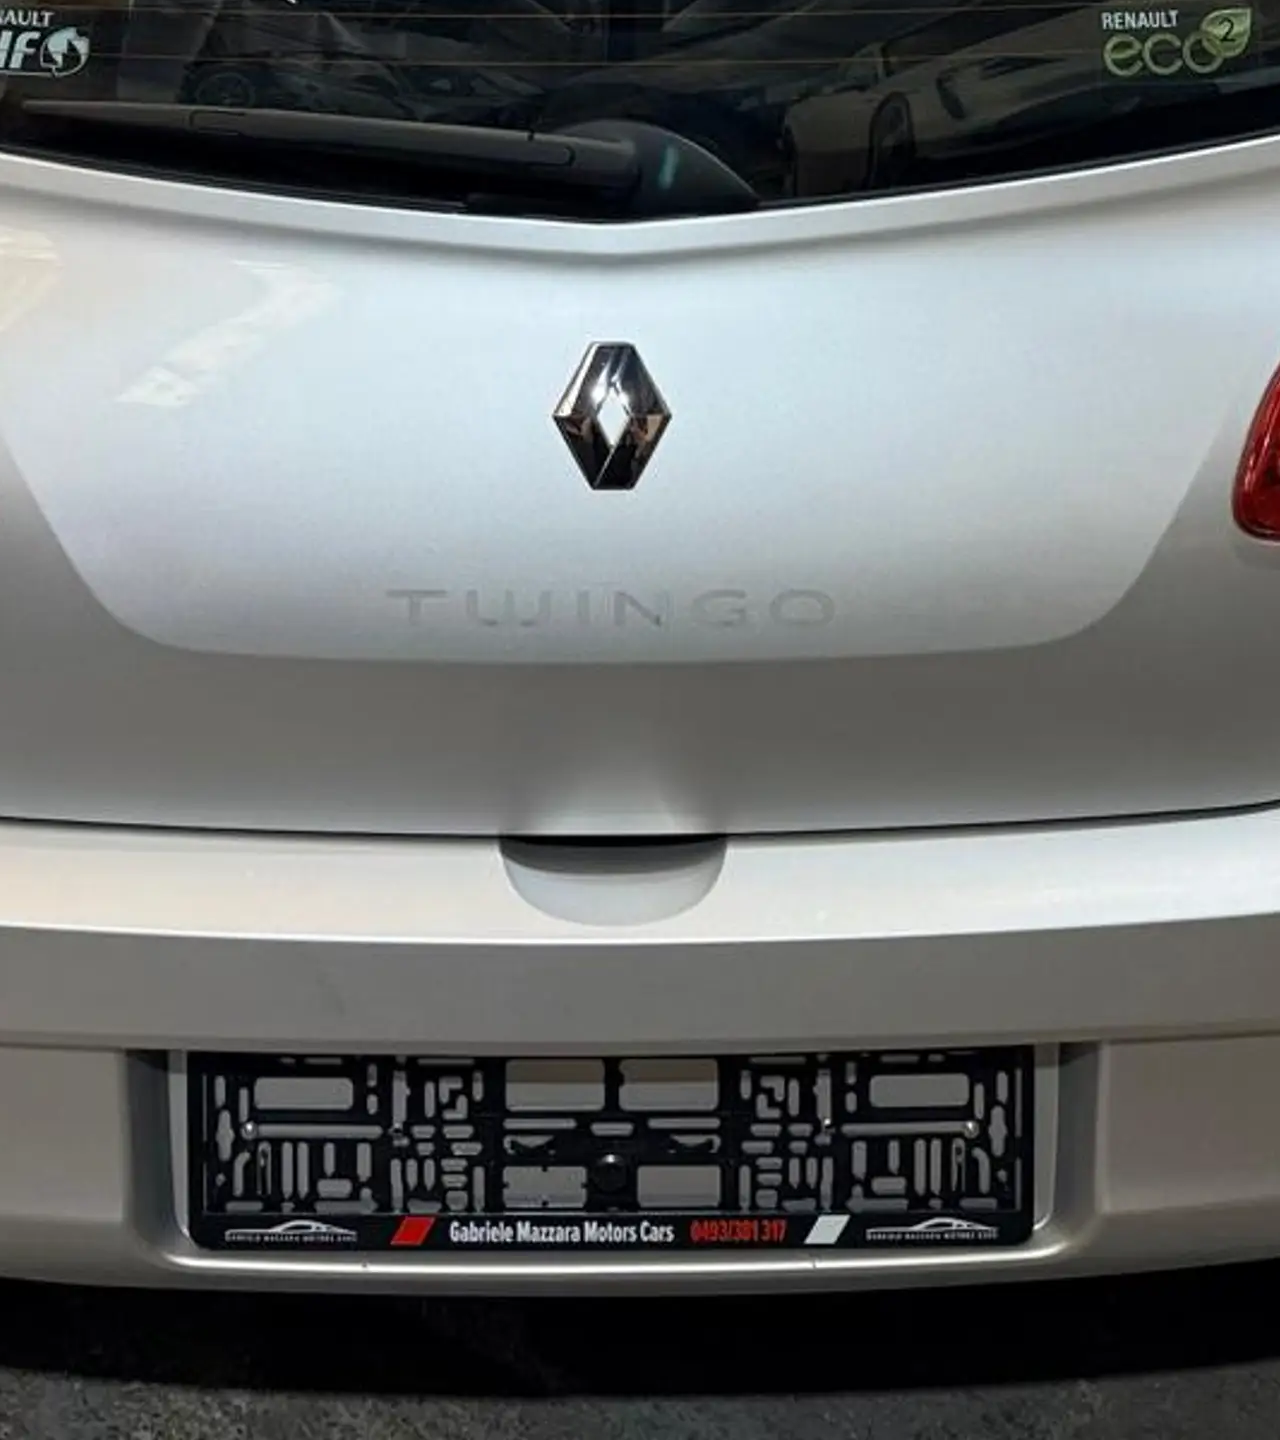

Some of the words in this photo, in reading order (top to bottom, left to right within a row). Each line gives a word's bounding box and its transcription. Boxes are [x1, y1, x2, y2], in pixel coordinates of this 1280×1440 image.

[1101, 9, 1180, 30] RENAULT
[385, 588, 836, 628] TWINGO
[449, 1220, 514, 1243] Gabriele
[516, 1221, 581, 1243] Mazzara
[583, 1220, 638, 1243] Motors
[639, 1220, 676, 1243] Cars
